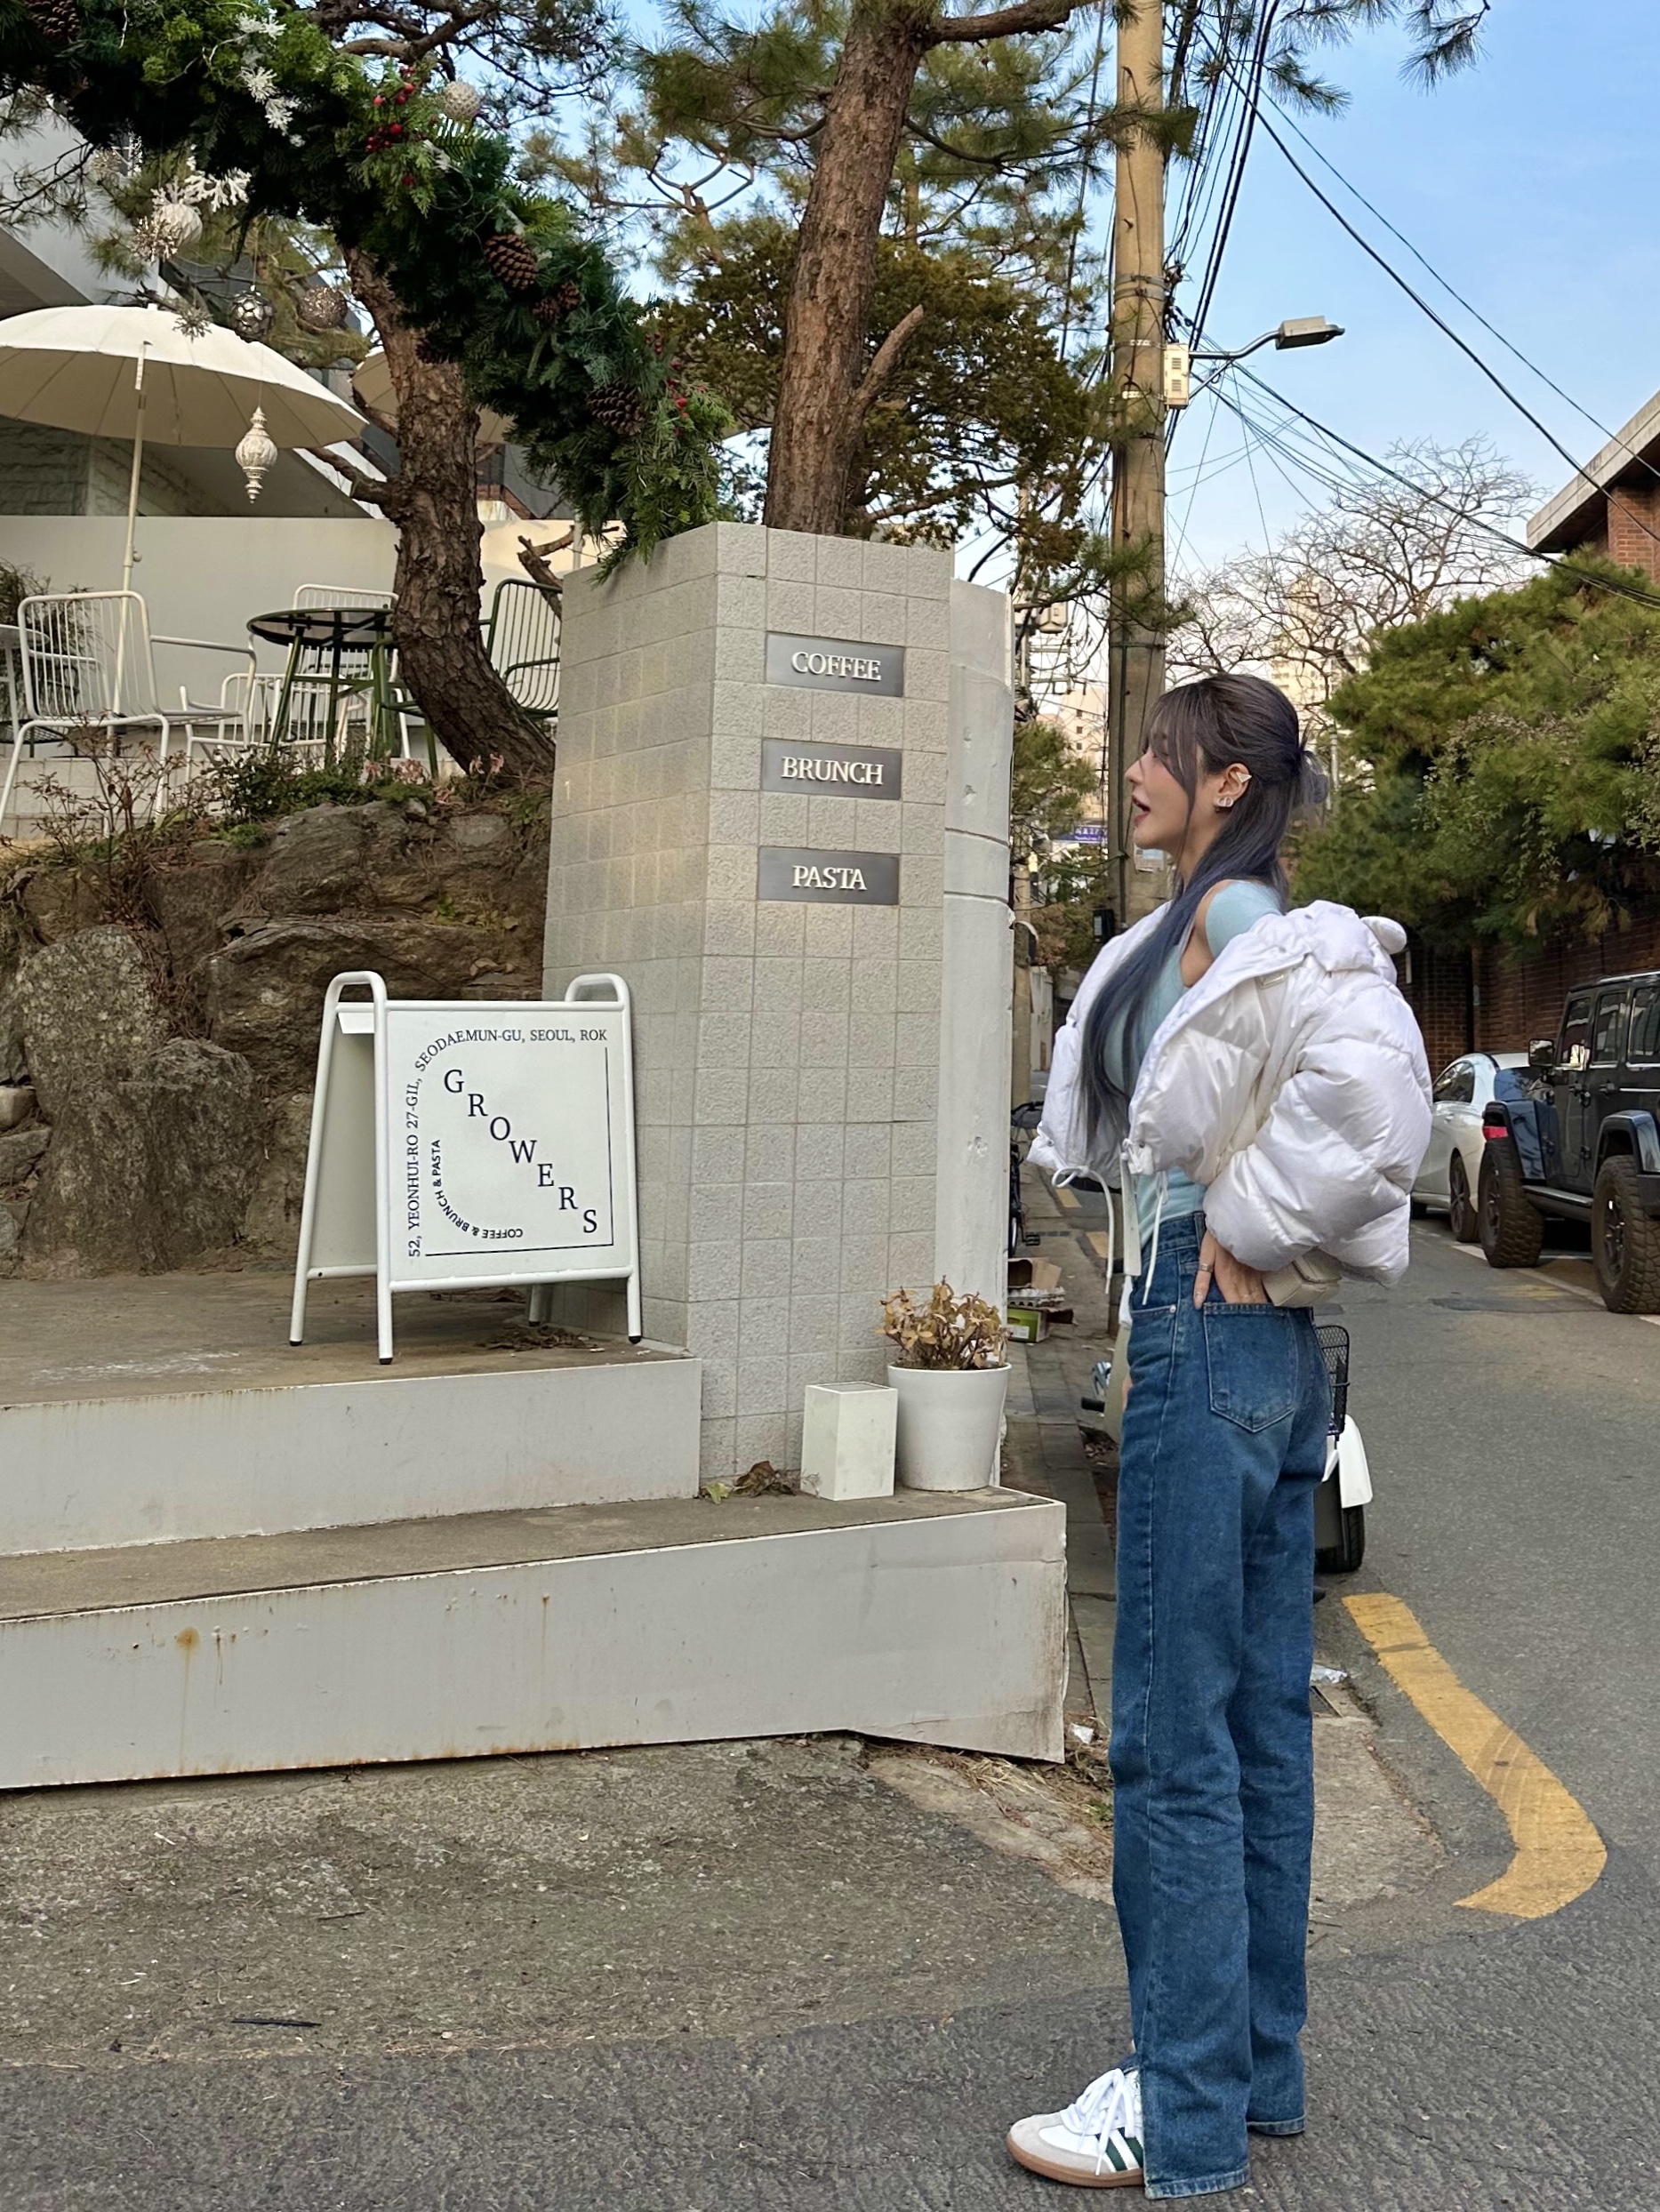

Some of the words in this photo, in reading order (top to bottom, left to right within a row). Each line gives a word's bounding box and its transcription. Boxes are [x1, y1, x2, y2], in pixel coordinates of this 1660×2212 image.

[791, 651, 882, 682] COFFEE
[781, 757, 884, 785] BRUNCH
[791, 865, 868, 891] PASTA
[530, 1029, 576, 1044] SEOUL,
[580, 1029, 608, 1042] ROK
[414, 1029, 526, 1072] SEODAEMUN-GU,
[405, 1078, 423, 1129] 27-GIL,
[430, 1139, 442, 1176] PASTA
[443, 1069, 598, 1234] GROWERS
[405, 1134, 421, 1231] YEONHUI-RO
[431, 1177, 443, 1188] &
[434, 1189, 471, 1233] BRUNCH
[470, 1225, 480, 1238] &
[480, 1228, 525, 1239] COFFEE
[407, 1234, 423, 1258] 52,
